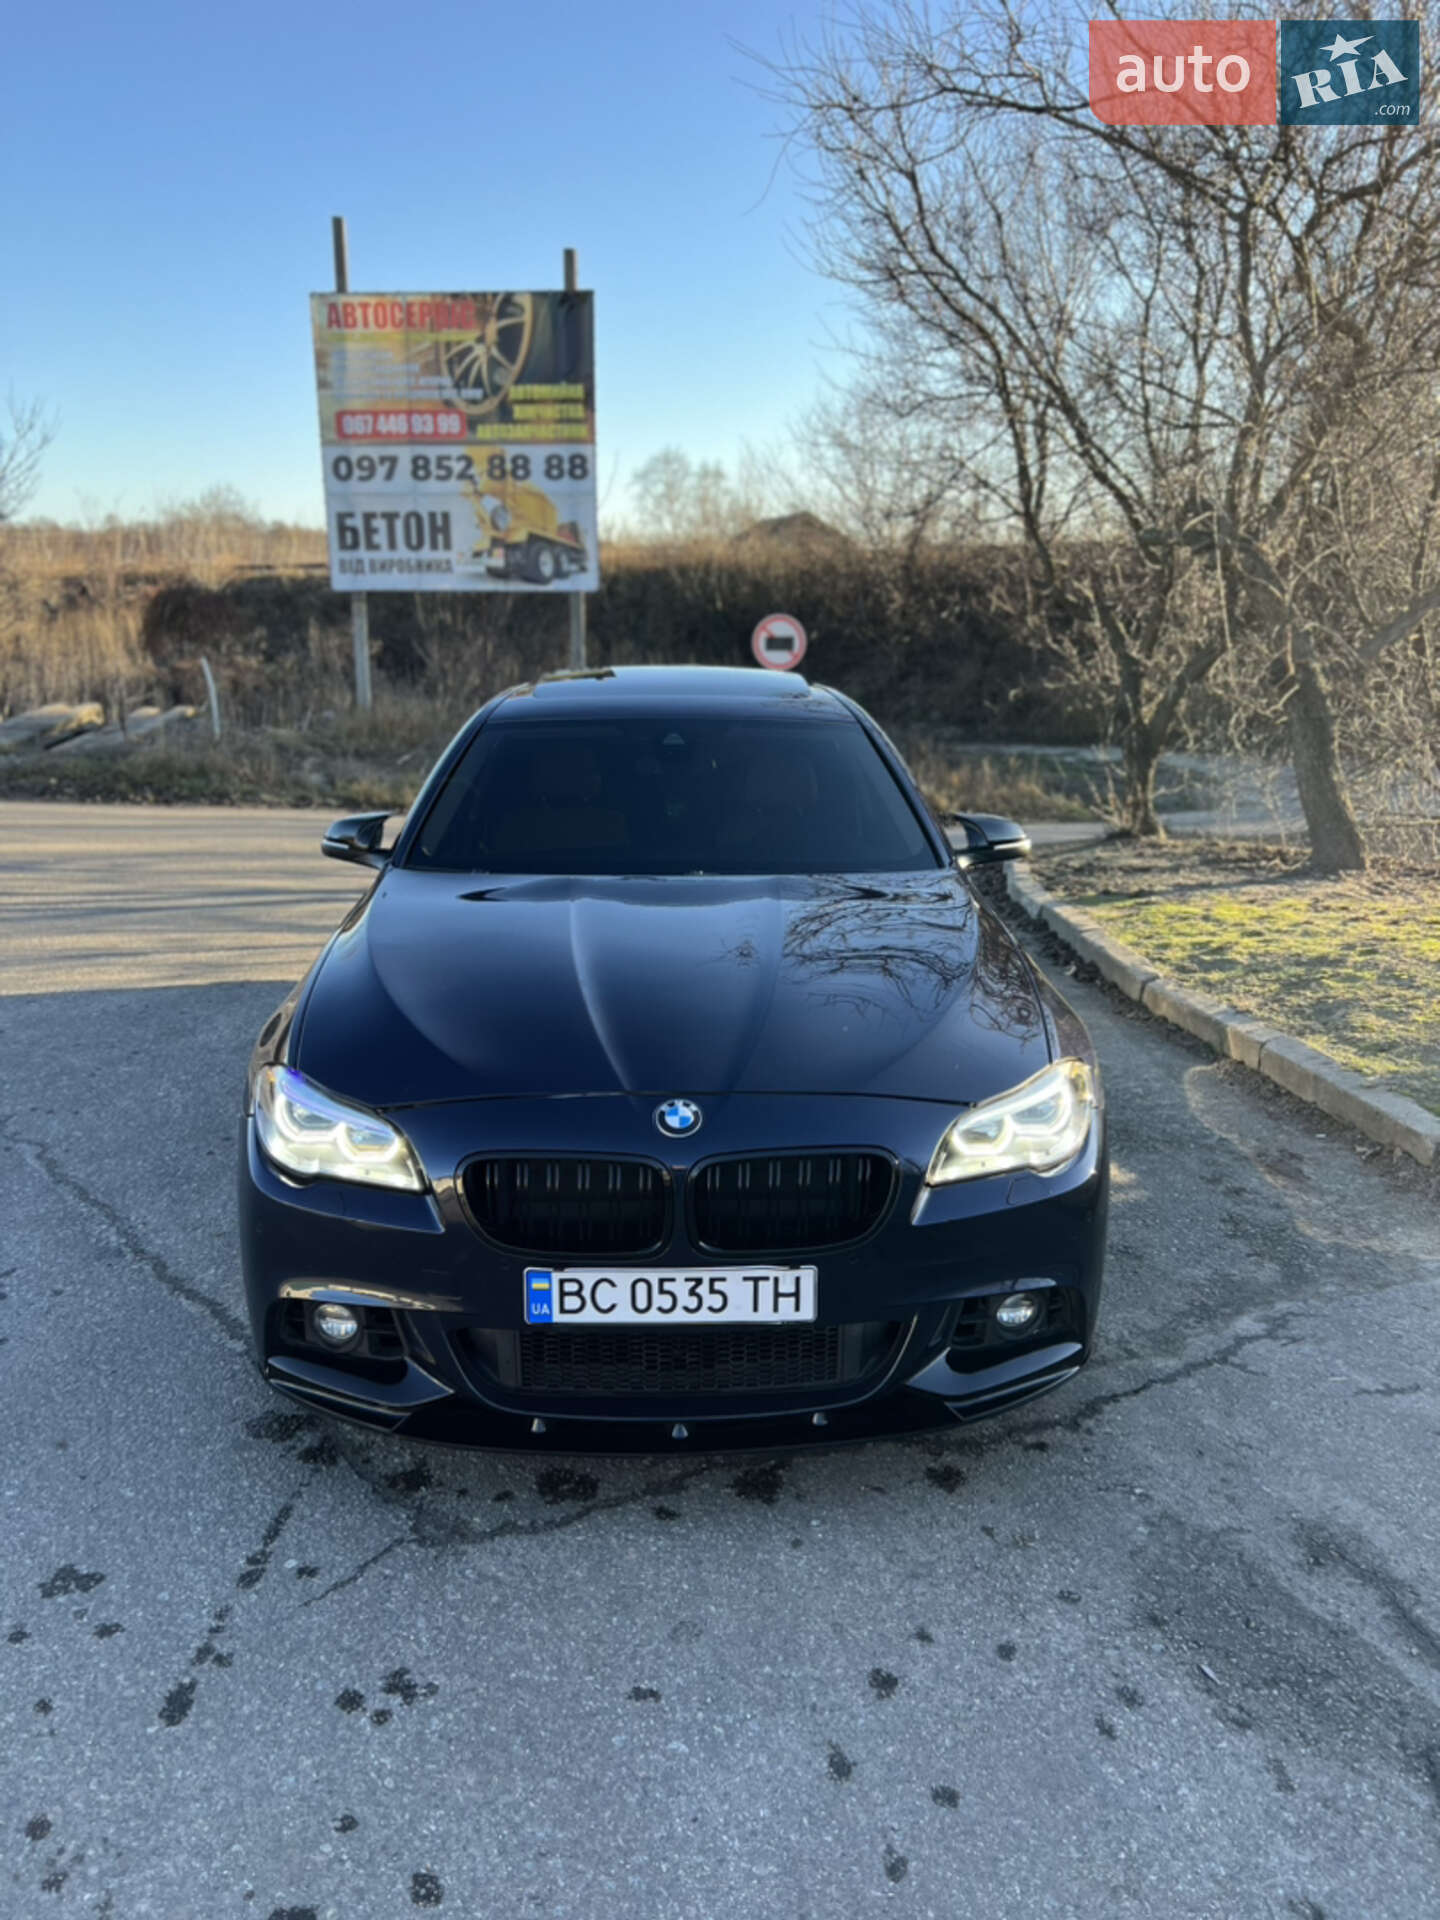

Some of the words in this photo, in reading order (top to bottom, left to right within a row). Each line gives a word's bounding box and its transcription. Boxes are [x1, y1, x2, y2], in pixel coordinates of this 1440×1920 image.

[332, 455, 399, 482] 097
[411, 455, 475, 482] 852
[486, 455, 532, 481] 88
[544, 454, 589, 481] 88
[336, 511, 452, 551] БЕТОН
[532, 1302, 550, 1316] UA
[558, 1277, 618, 1315] BC
[630, 1277, 729, 1314] 0535
[742, 1275, 801, 1313] TH
